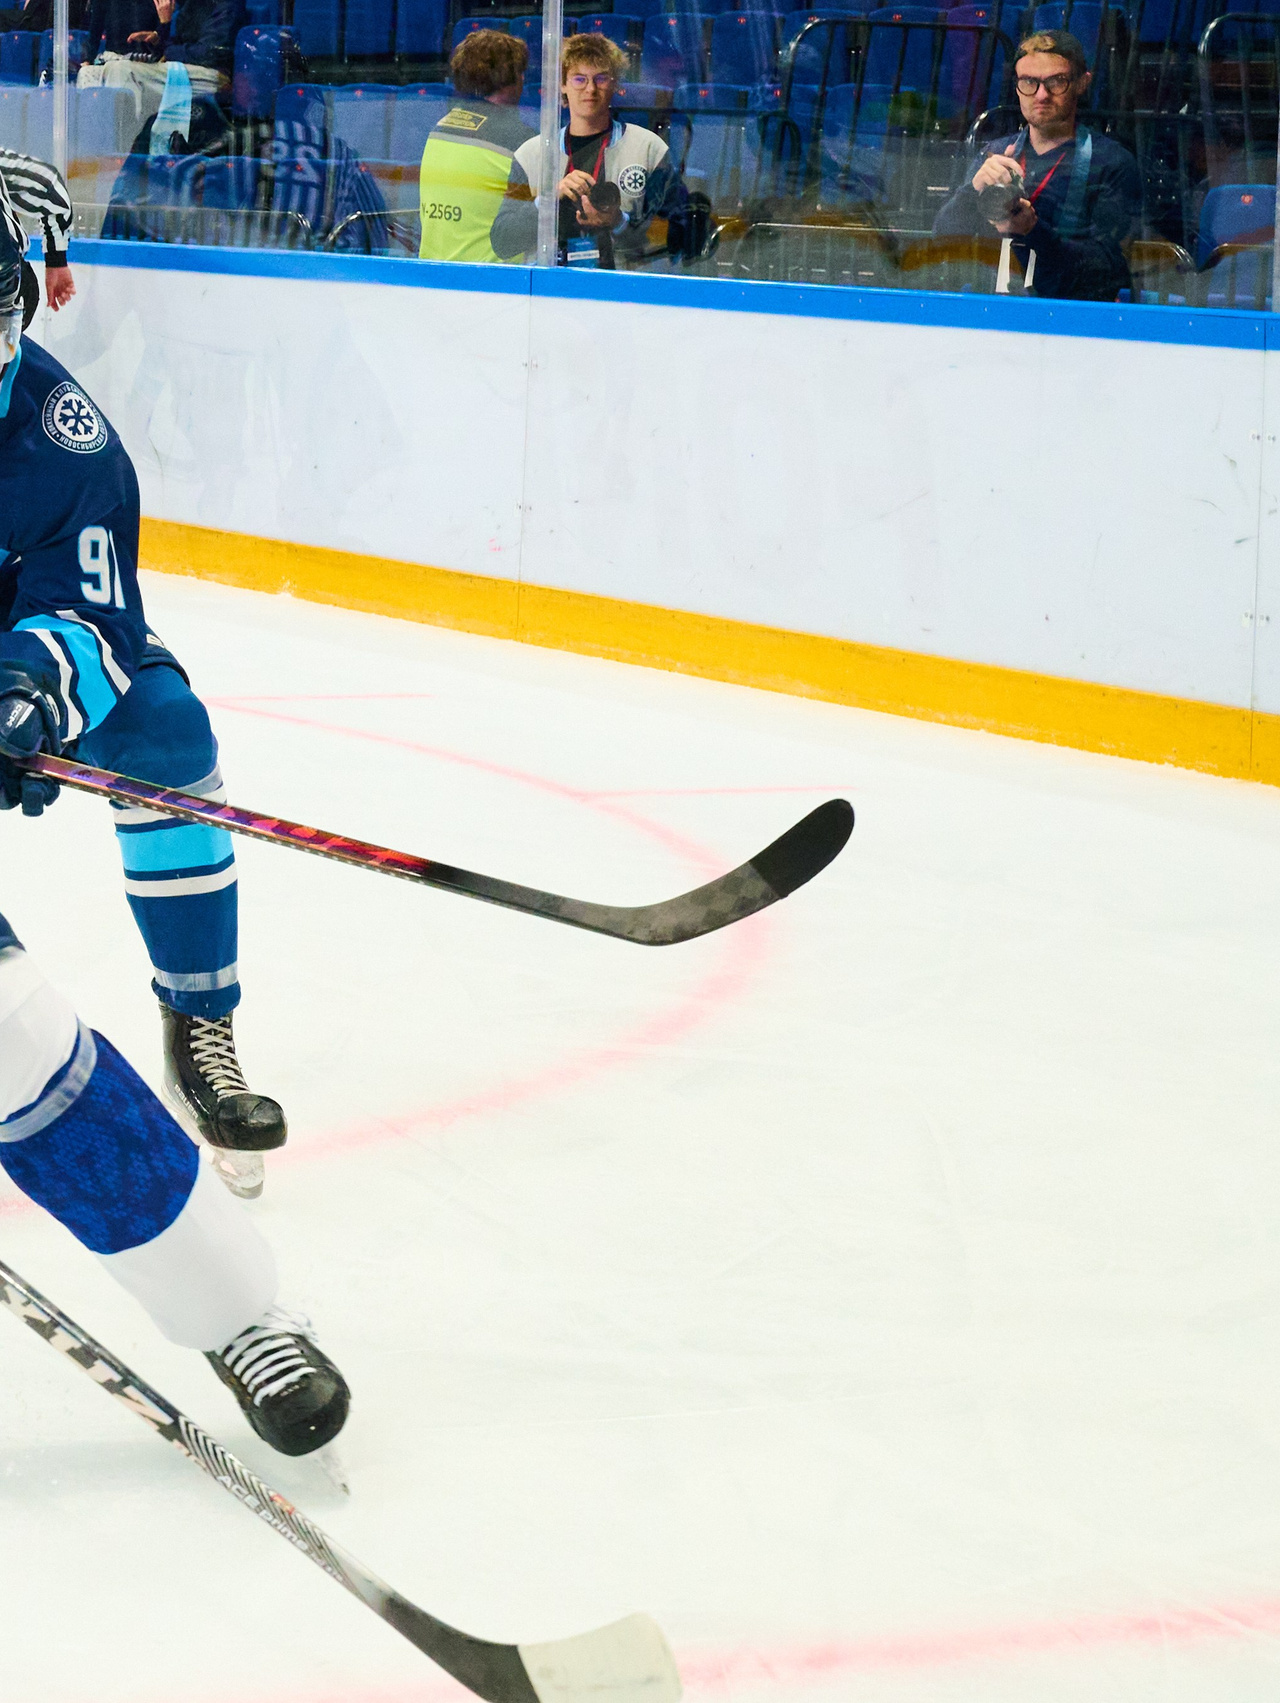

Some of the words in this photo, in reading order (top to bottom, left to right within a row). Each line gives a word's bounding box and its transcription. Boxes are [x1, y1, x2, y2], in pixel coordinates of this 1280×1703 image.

[78, 525, 126, 609] 91
[6, 703, 23, 728] CCM
[174, 1084, 198, 1119] BAUER
[216, 1475, 260, 1509] ACE
